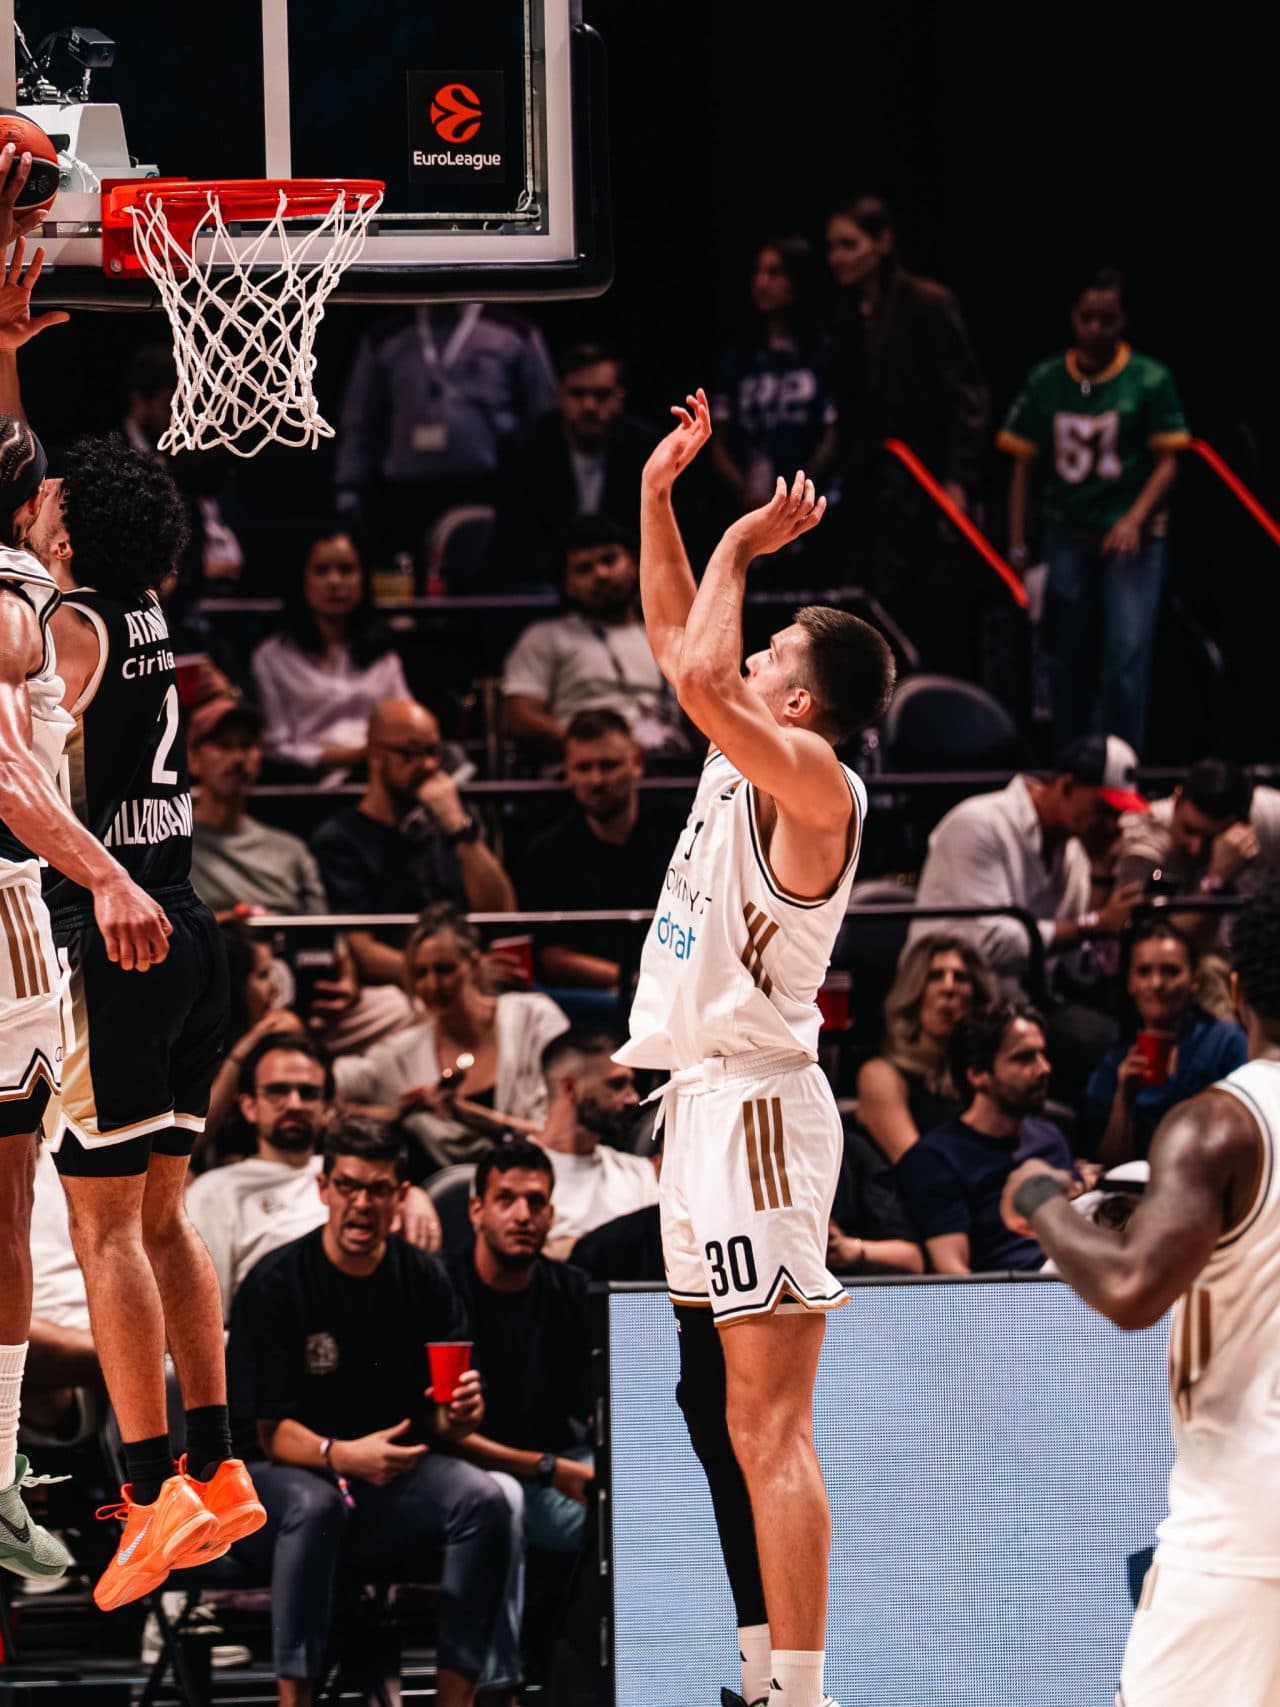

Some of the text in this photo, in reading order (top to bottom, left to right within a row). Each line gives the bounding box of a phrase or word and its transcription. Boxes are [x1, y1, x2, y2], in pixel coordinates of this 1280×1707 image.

[412, 151, 502, 171] EuroLeague
[151, 683, 180, 786] 2
[704, 1235, 758, 1297] 30
